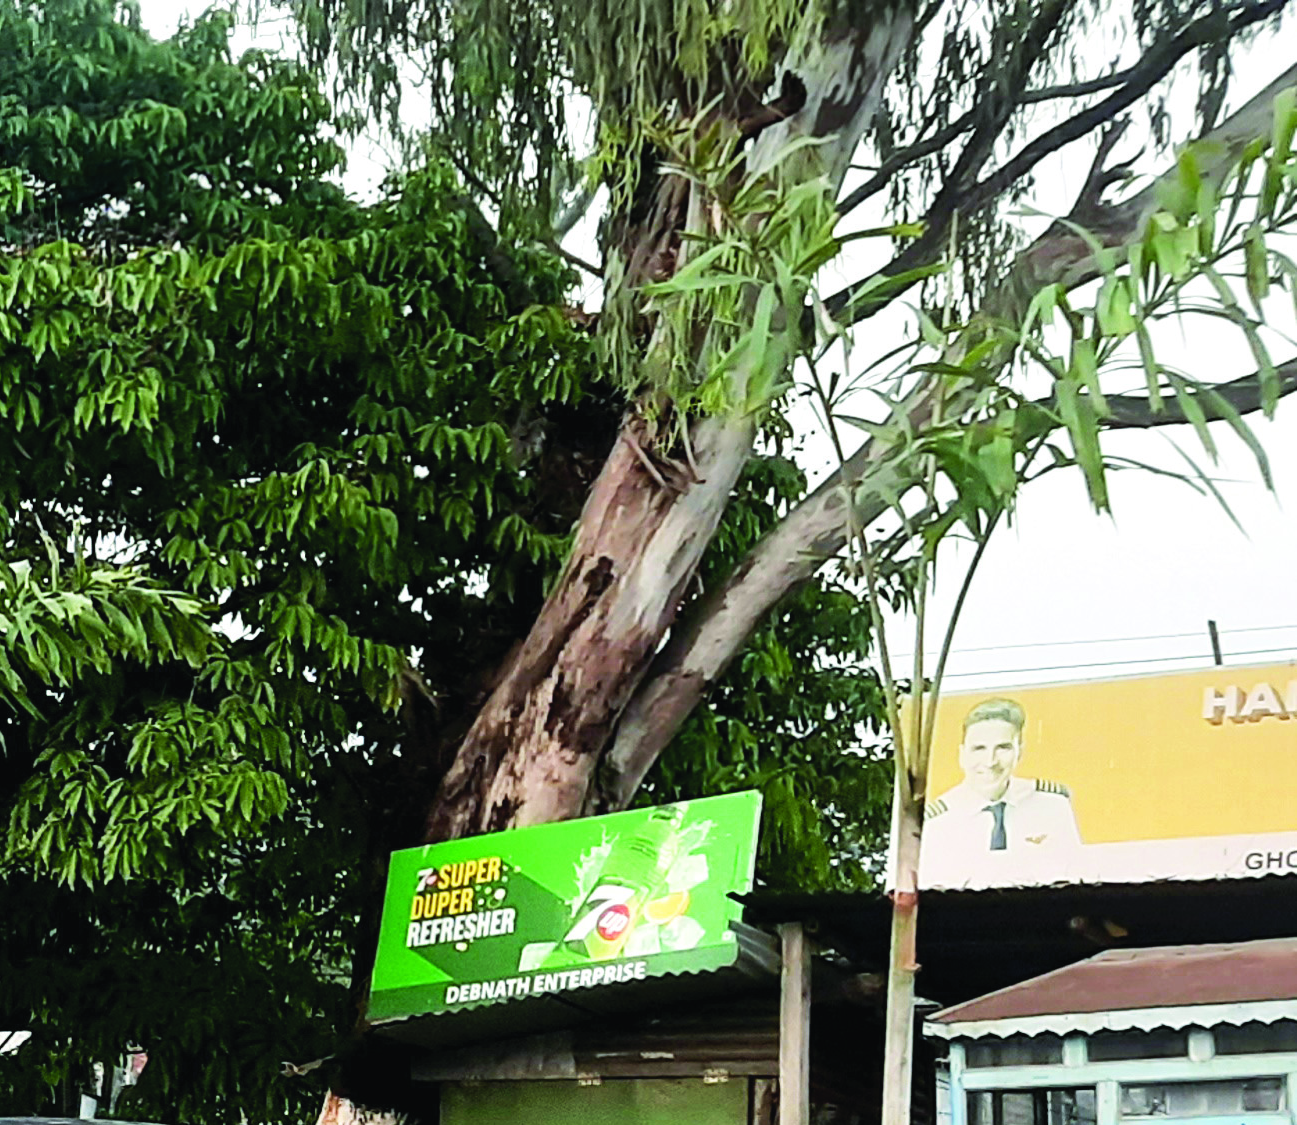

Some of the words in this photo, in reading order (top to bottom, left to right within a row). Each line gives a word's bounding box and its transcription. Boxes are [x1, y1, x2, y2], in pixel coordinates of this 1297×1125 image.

[436, 857, 502, 890] SUPER
[410, 888, 474, 920] DUPER
[407, 908, 517, 947] REFRESHER
[445, 976, 531, 1004] DEBNATH
[533, 961, 647, 992] ENTERPRISE
